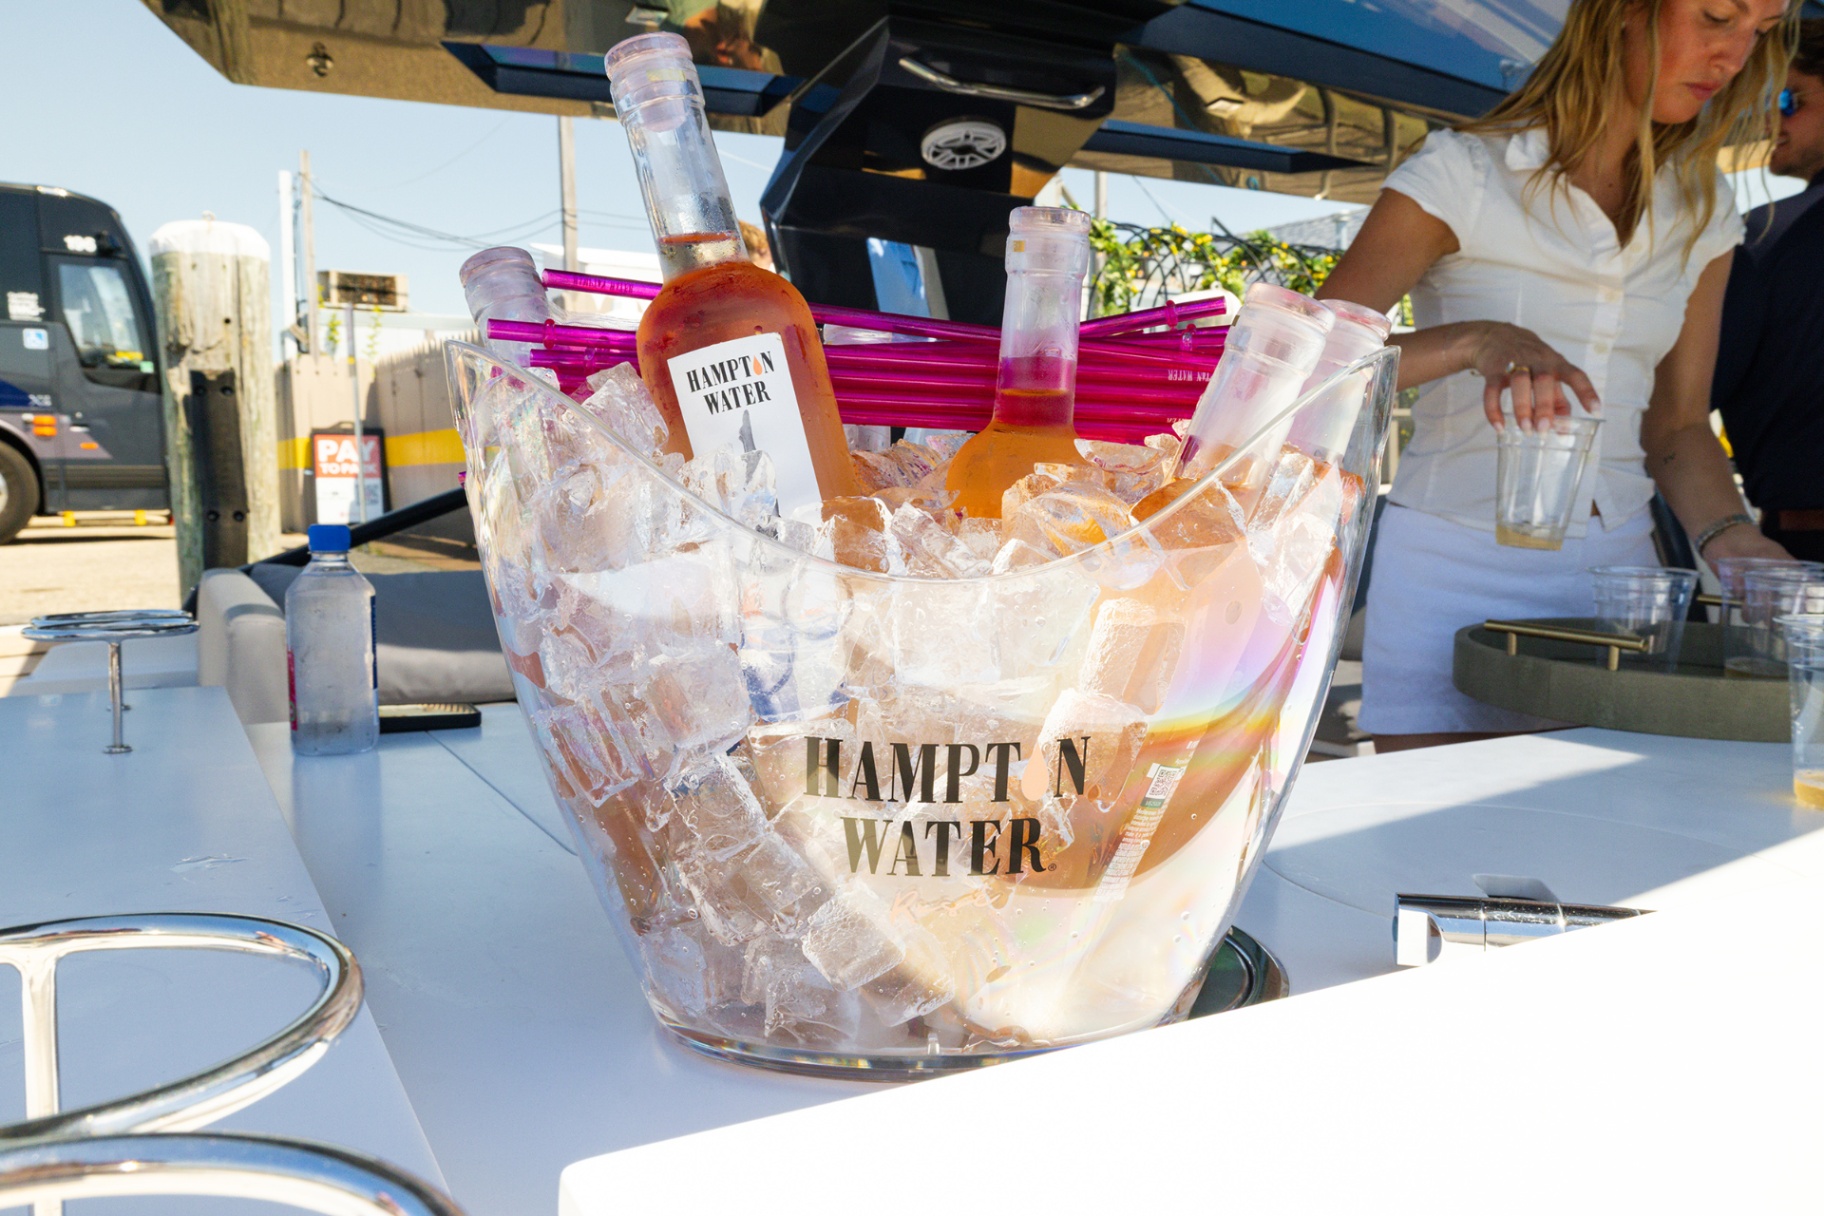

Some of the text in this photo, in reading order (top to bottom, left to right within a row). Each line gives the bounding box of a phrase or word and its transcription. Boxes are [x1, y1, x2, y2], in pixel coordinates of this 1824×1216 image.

[686, 350, 775, 393] HAMPTON
[703, 380, 772, 415] WATER
[317, 439, 376, 463] PAY
[319, 462, 340, 475] TO
[803, 735, 1091, 803] HAMPTON
